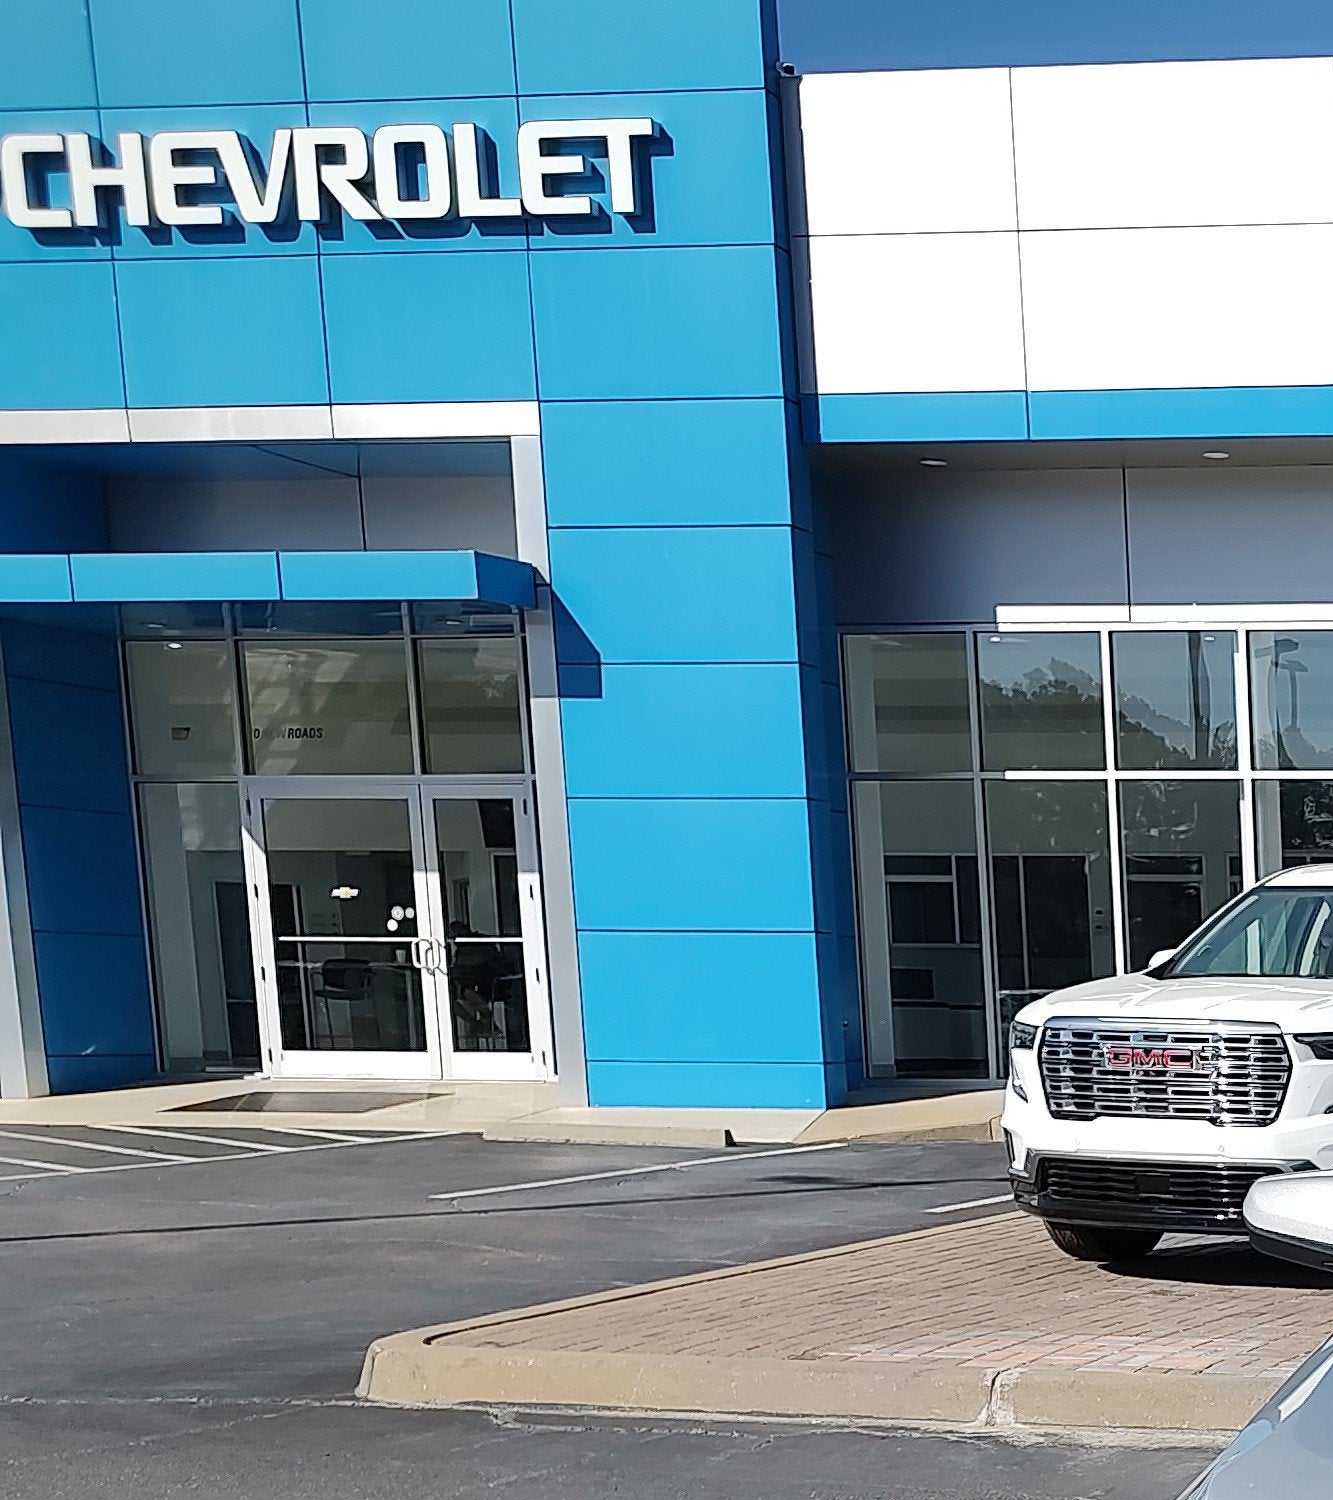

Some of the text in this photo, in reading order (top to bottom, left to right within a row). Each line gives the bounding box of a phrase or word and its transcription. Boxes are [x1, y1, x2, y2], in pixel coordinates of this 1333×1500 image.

[1, 117, 654, 229] CHEVROLET
[287, 727, 323, 739] ROADS
[1106, 1047, 1193, 1069] GMC
